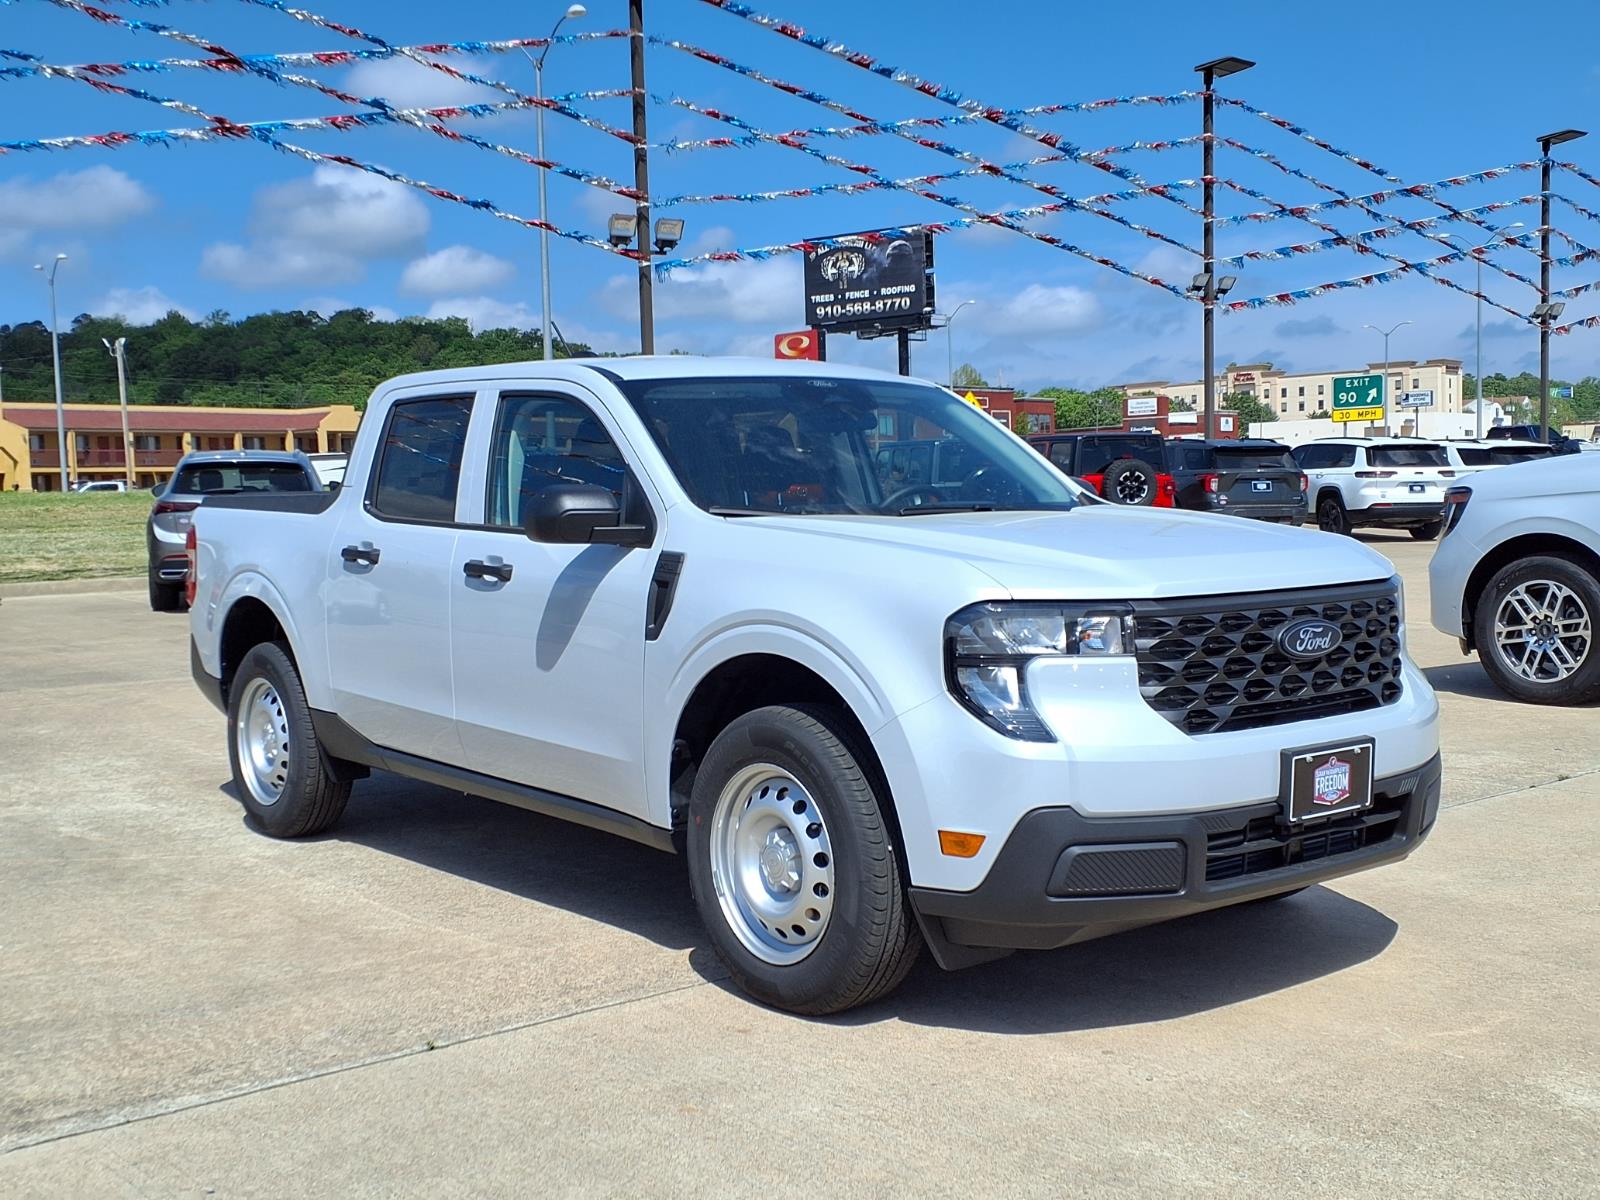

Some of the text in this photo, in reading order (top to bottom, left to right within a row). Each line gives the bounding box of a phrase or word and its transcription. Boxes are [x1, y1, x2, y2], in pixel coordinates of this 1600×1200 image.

[811, 285, 915, 303] TREES FENCE ROOFING
[816, 296, 911, 319] 910-568-8770
[1345, 378, 1370, 388] EXIT
[1338, 391, 1357, 404] 90
[1340, 409, 1377, 420] 30 MPH
[1296, 626, 1332, 652] Ford
[1315, 772, 1349, 797] FREEDOM
